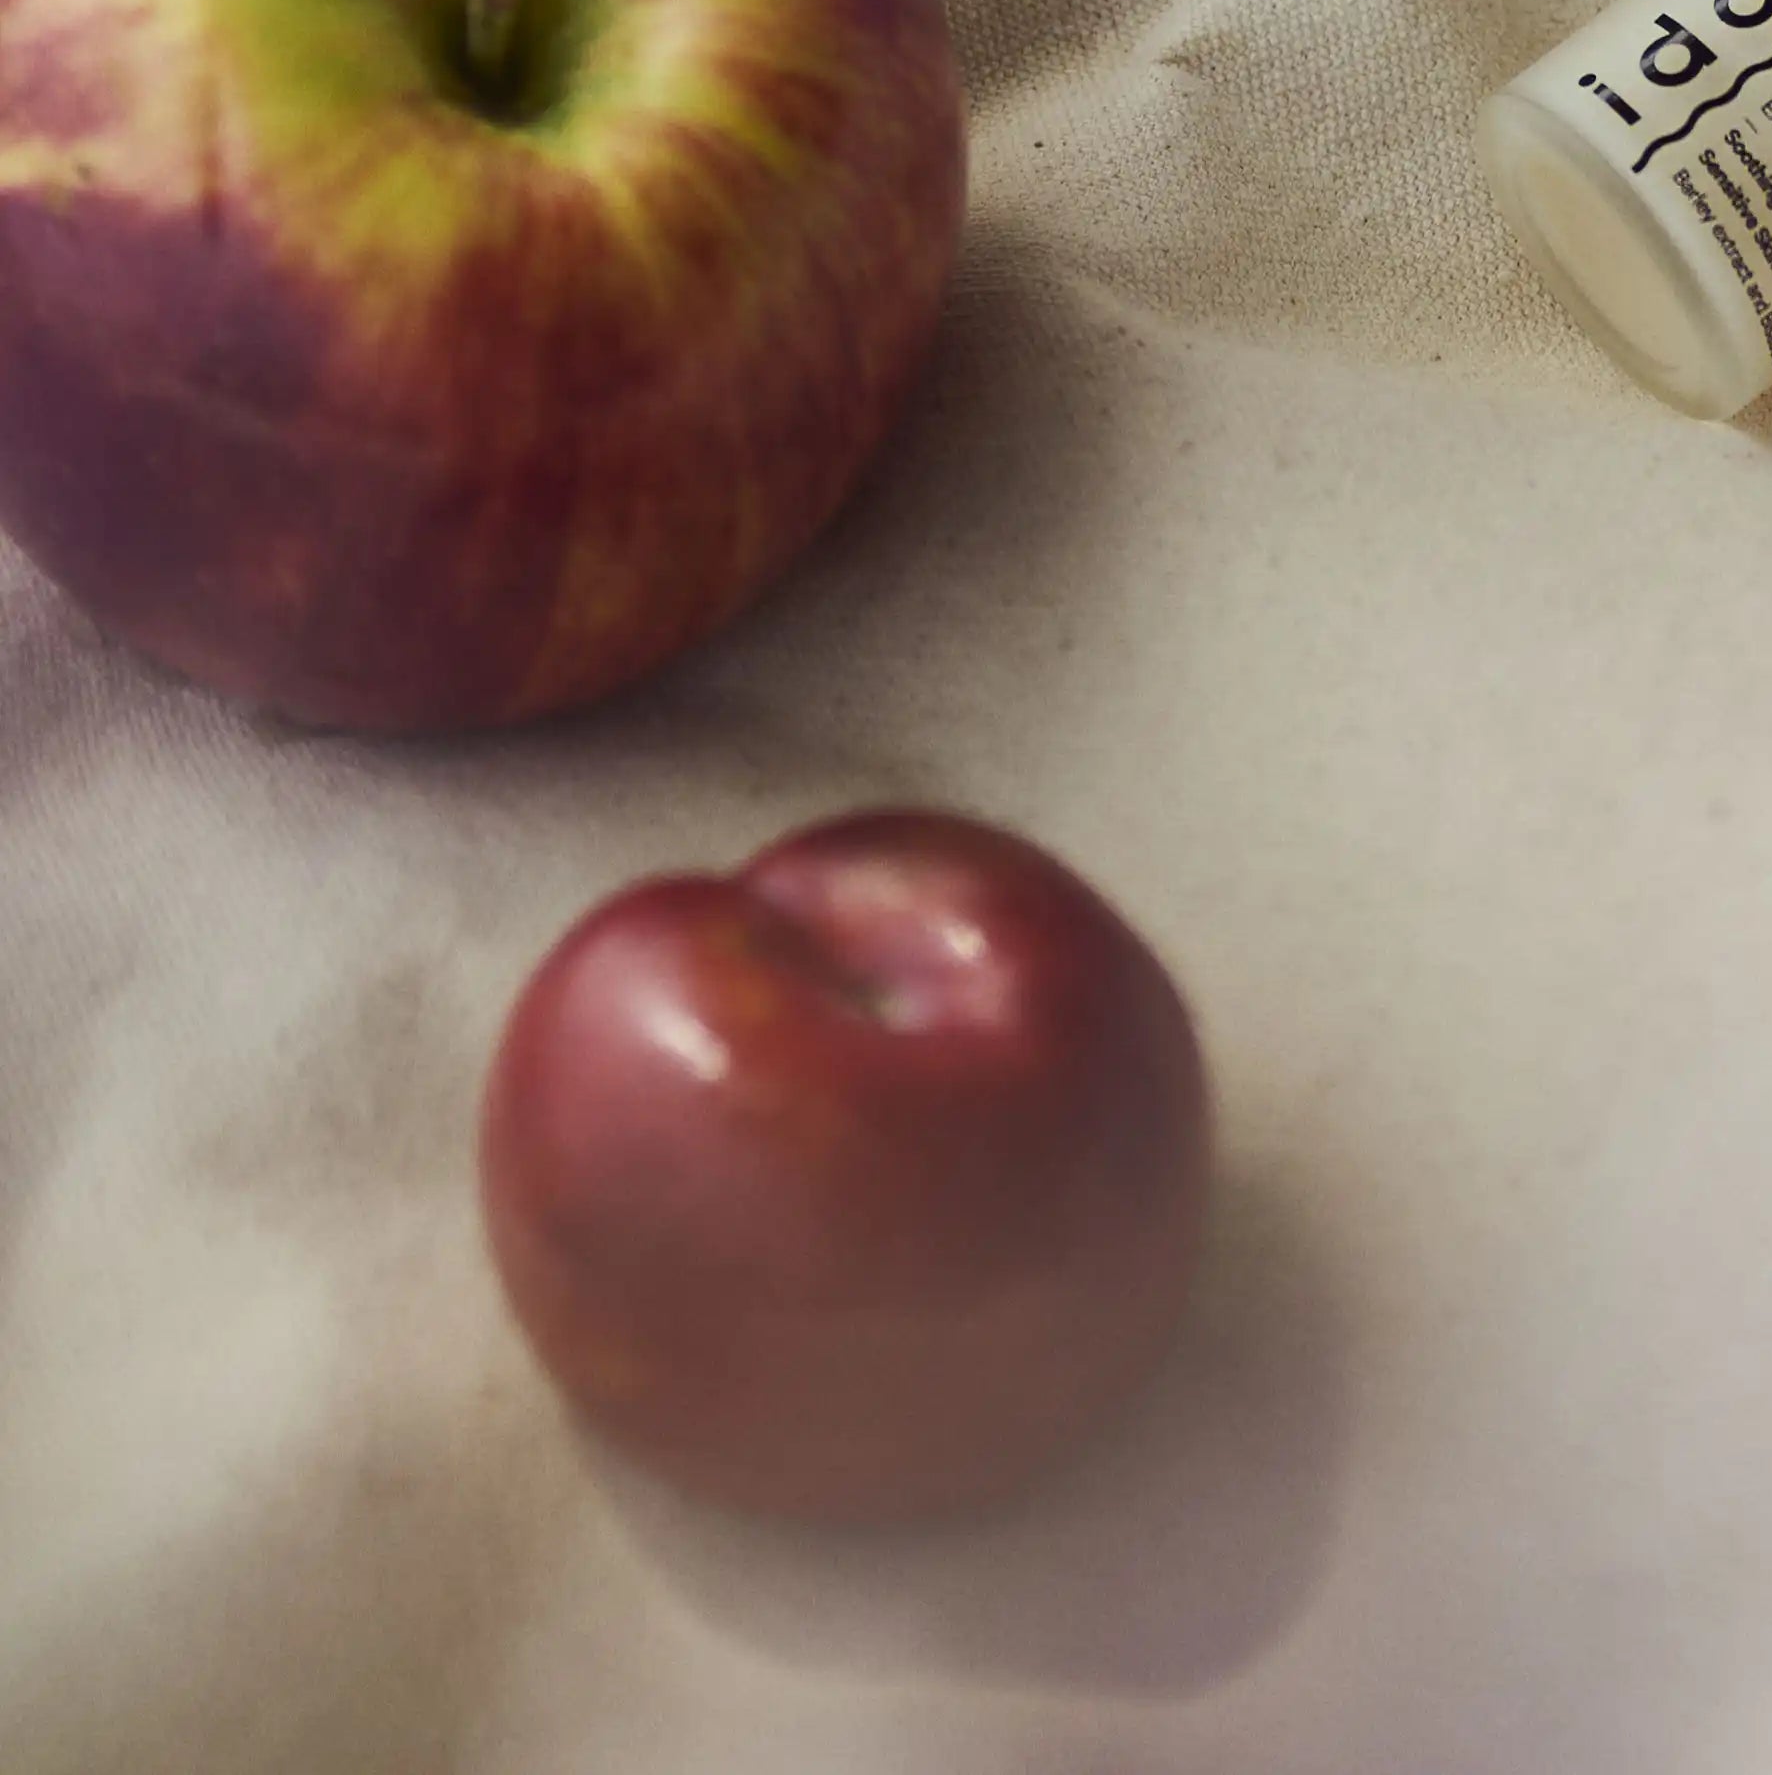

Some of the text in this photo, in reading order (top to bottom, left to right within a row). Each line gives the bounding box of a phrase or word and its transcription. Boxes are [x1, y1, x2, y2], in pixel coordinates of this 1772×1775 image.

[1673, 168, 1717, 224] Barley
[1712, 224, 1753, 284] extract
[1746, 282, 1771, 316] and
[1698, 148, 1758, 230] Sensitive
